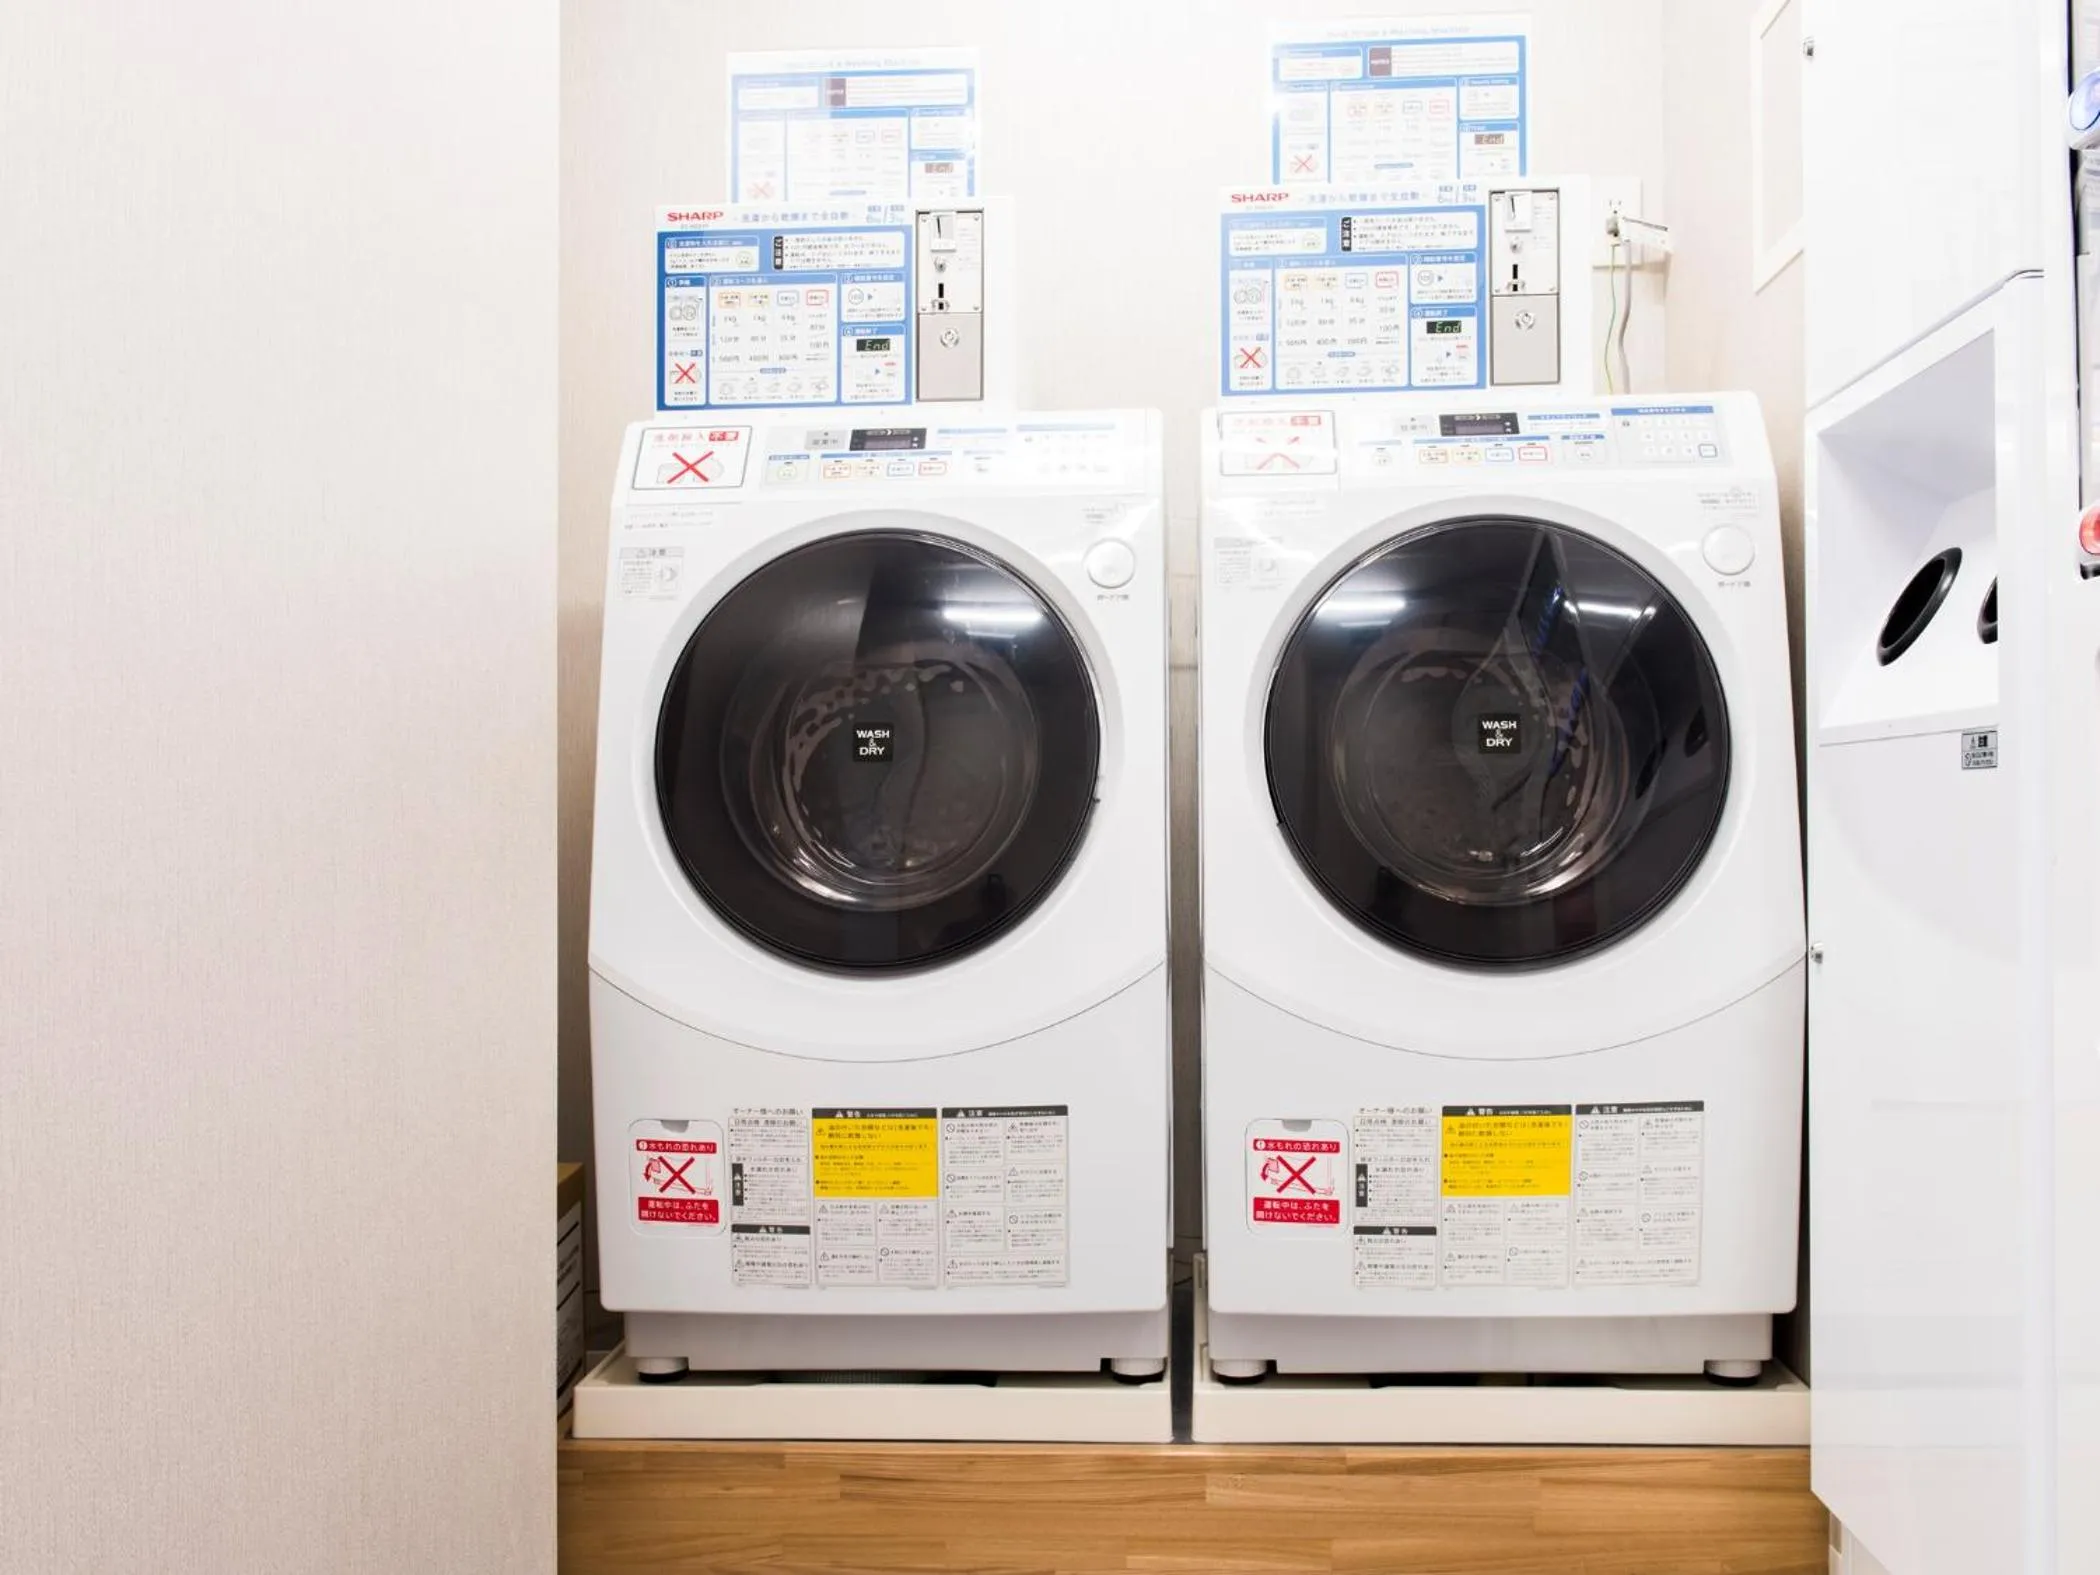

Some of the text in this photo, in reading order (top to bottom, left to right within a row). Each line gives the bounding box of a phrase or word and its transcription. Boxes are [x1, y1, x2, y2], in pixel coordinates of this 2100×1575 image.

[1231, 192, 1289, 203] SHARP
[667, 211, 724, 222] SHARP
[1482, 720, 1517, 729] WASH
[856, 730, 890, 738] WASH
[1495, 729, 1504, 738] &
[868, 738, 877, 747] &
[1486, 738, 1513, 747] DRY
[859, 747, 885, 755] DRY
[649, 1142, 714, 1152] 水もれの恐れあり
[1267, 1142, 1337, 1152] 水もれの恐れあり
[648, 1201, 710, 1211] 運転中は、ふたを
[1263, 1200, 1330, 1211] 運転中は、ふたを
[641, 1210, 716, 1222] 開けないでください。
[1256, 1210, 1337, 1222] 開けないでください。
